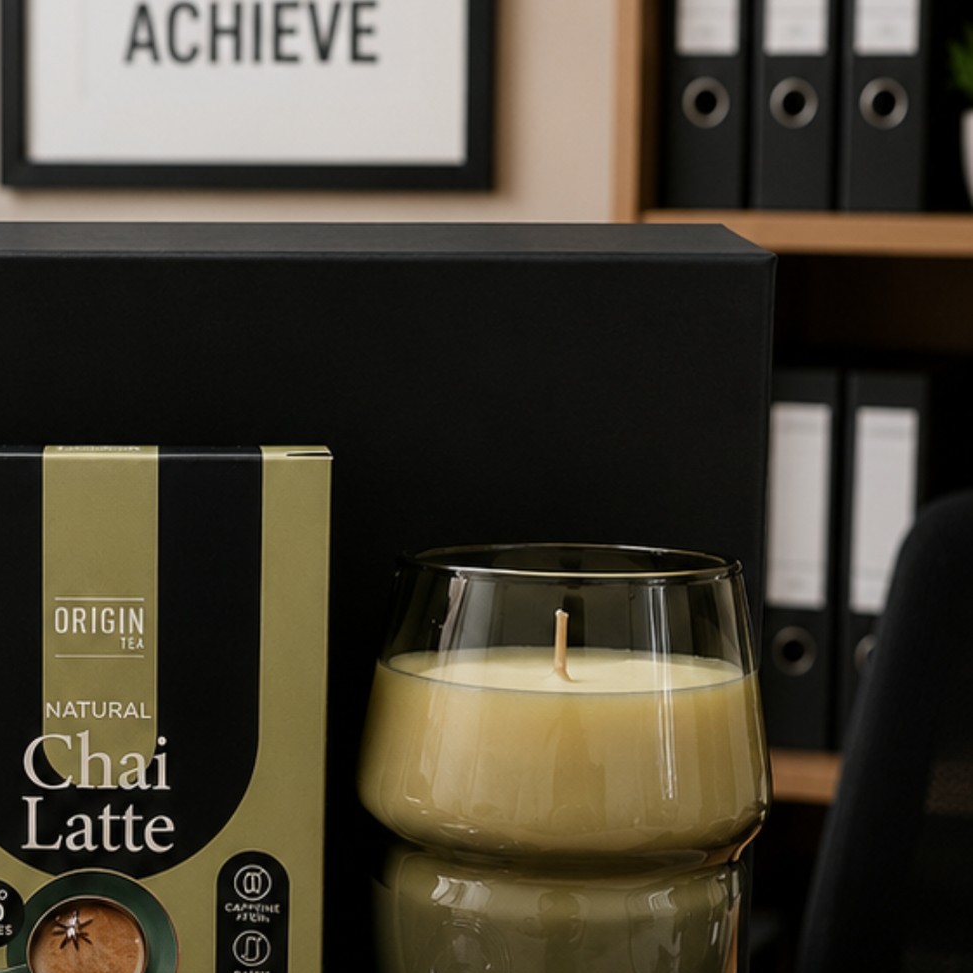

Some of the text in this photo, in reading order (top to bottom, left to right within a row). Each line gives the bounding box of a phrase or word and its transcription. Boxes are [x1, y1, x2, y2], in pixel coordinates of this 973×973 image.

[125, 1, 378, 64] ACHIEVE
[54, 606, 144, 635] ORIGIN
[120, 636, 144, 650] TEA
[46, 701, 152, 719] NATURAL
[23, 730, 170, 790] Chai
[21, 796, 175, 852] Latte
